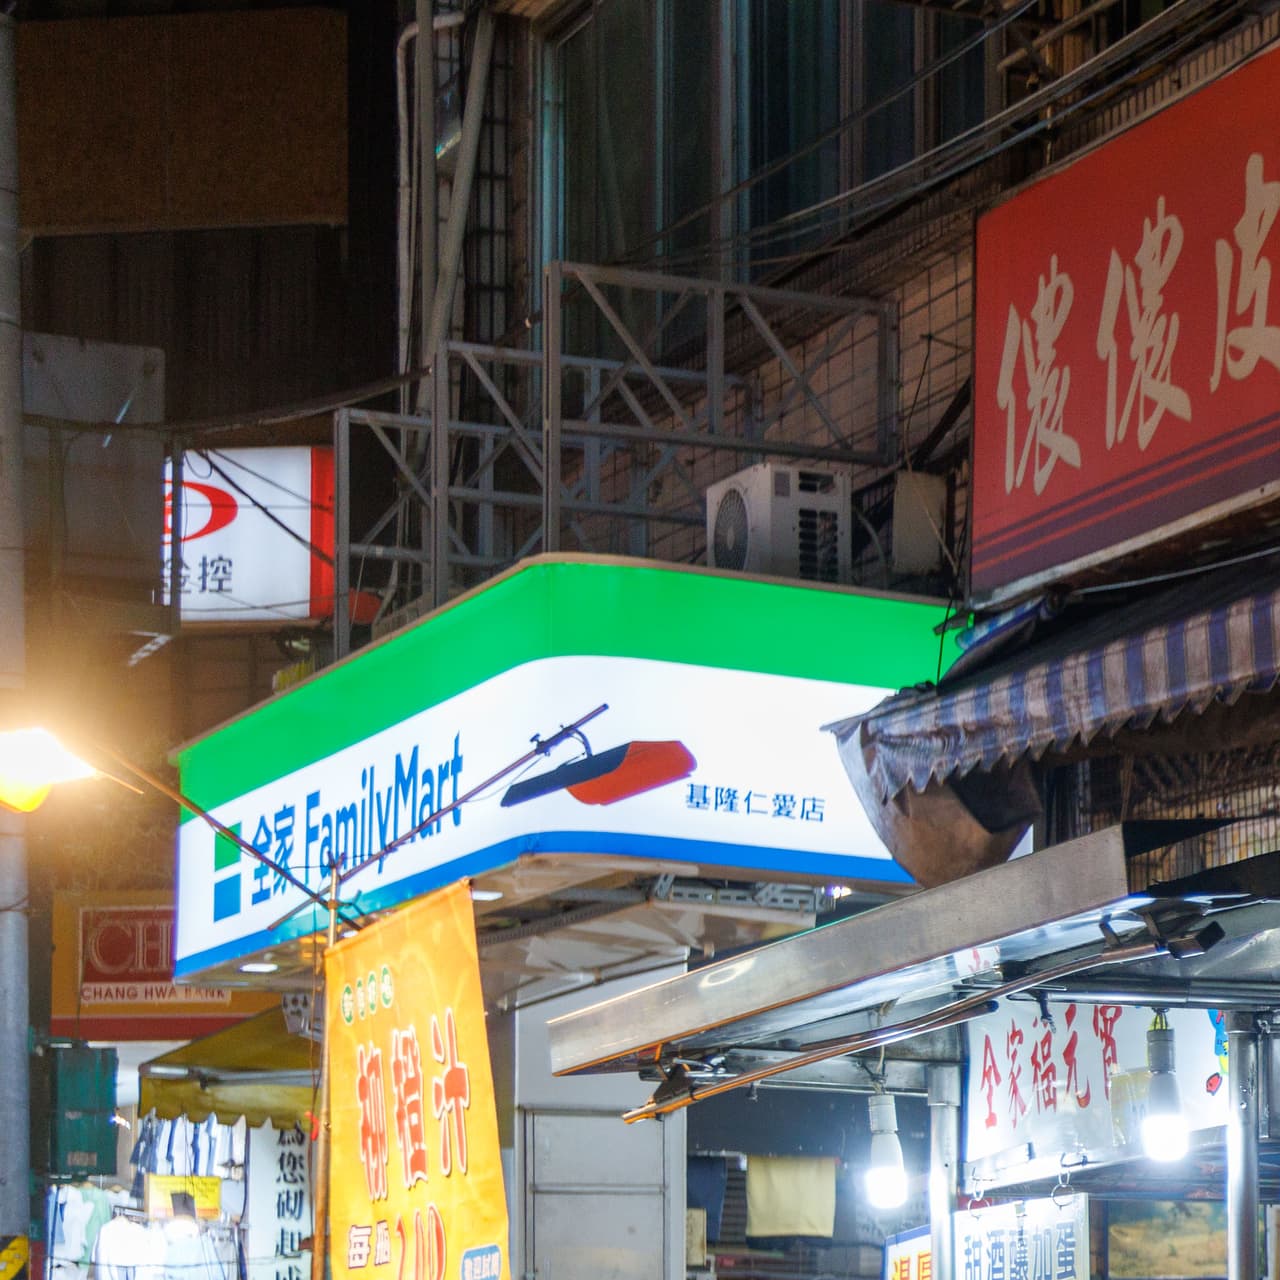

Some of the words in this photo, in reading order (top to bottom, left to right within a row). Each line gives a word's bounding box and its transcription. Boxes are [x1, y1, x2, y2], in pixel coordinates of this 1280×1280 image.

[305, 731, 464, 886] FamilyMart
[686, 783, 826, 823] 基隆仁愛店
[252, 804, 296, 906] 全家
[81, 987, 139, 1000] CHANG
[144, 986, 178, 999] HWA
